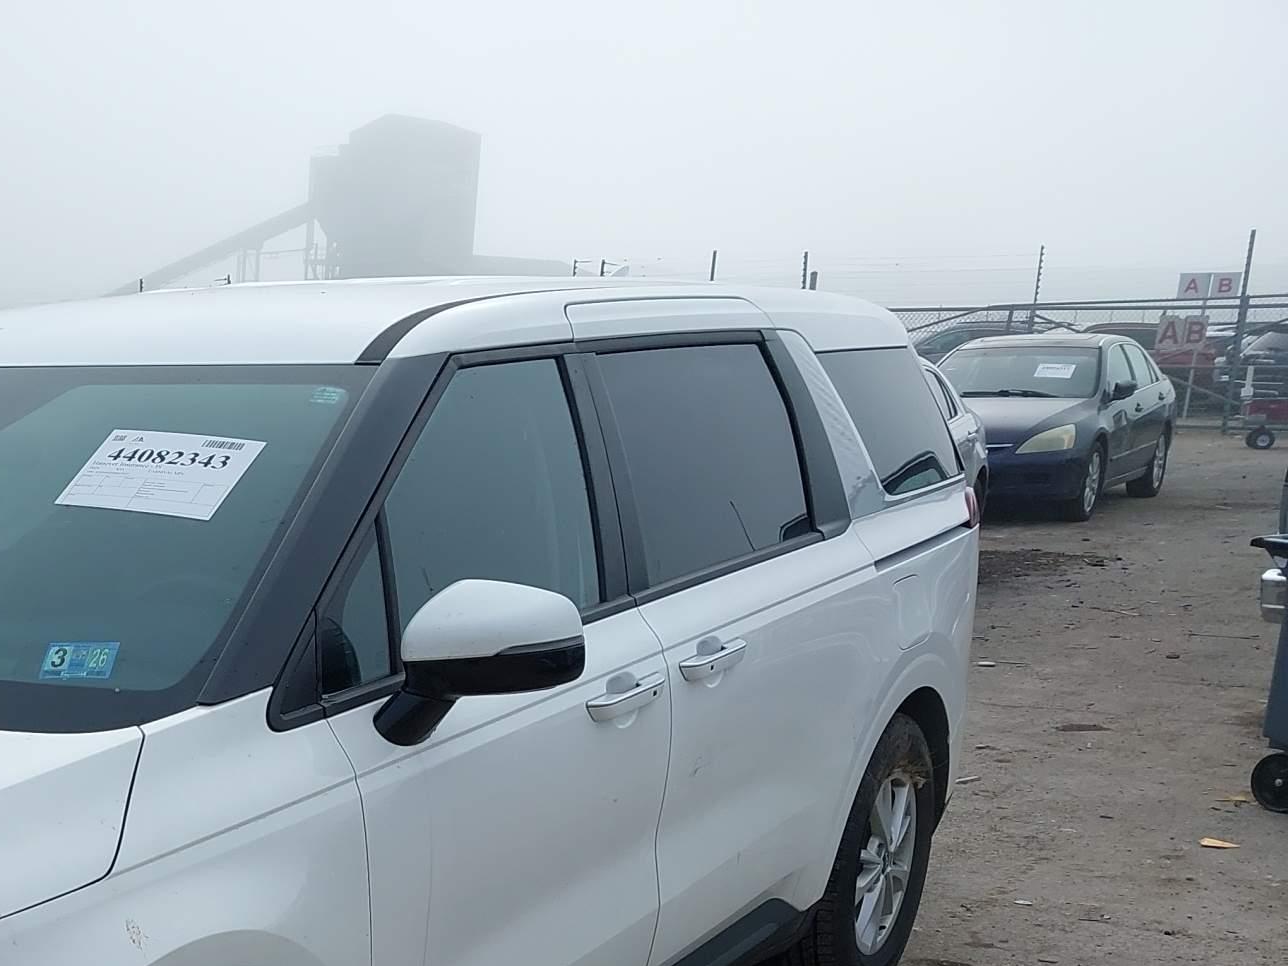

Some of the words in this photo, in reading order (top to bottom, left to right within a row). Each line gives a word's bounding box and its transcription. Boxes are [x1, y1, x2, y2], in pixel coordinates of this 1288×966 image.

[1184, 279, 1199, 294] A
[1218, 278, 1232, 293] B
[1159, 321, 1179, 344] A
[1186, 321, 1205, 343] B
[107, 447, 231, 470] 44082343
[51, 648, 67, 667] 3
